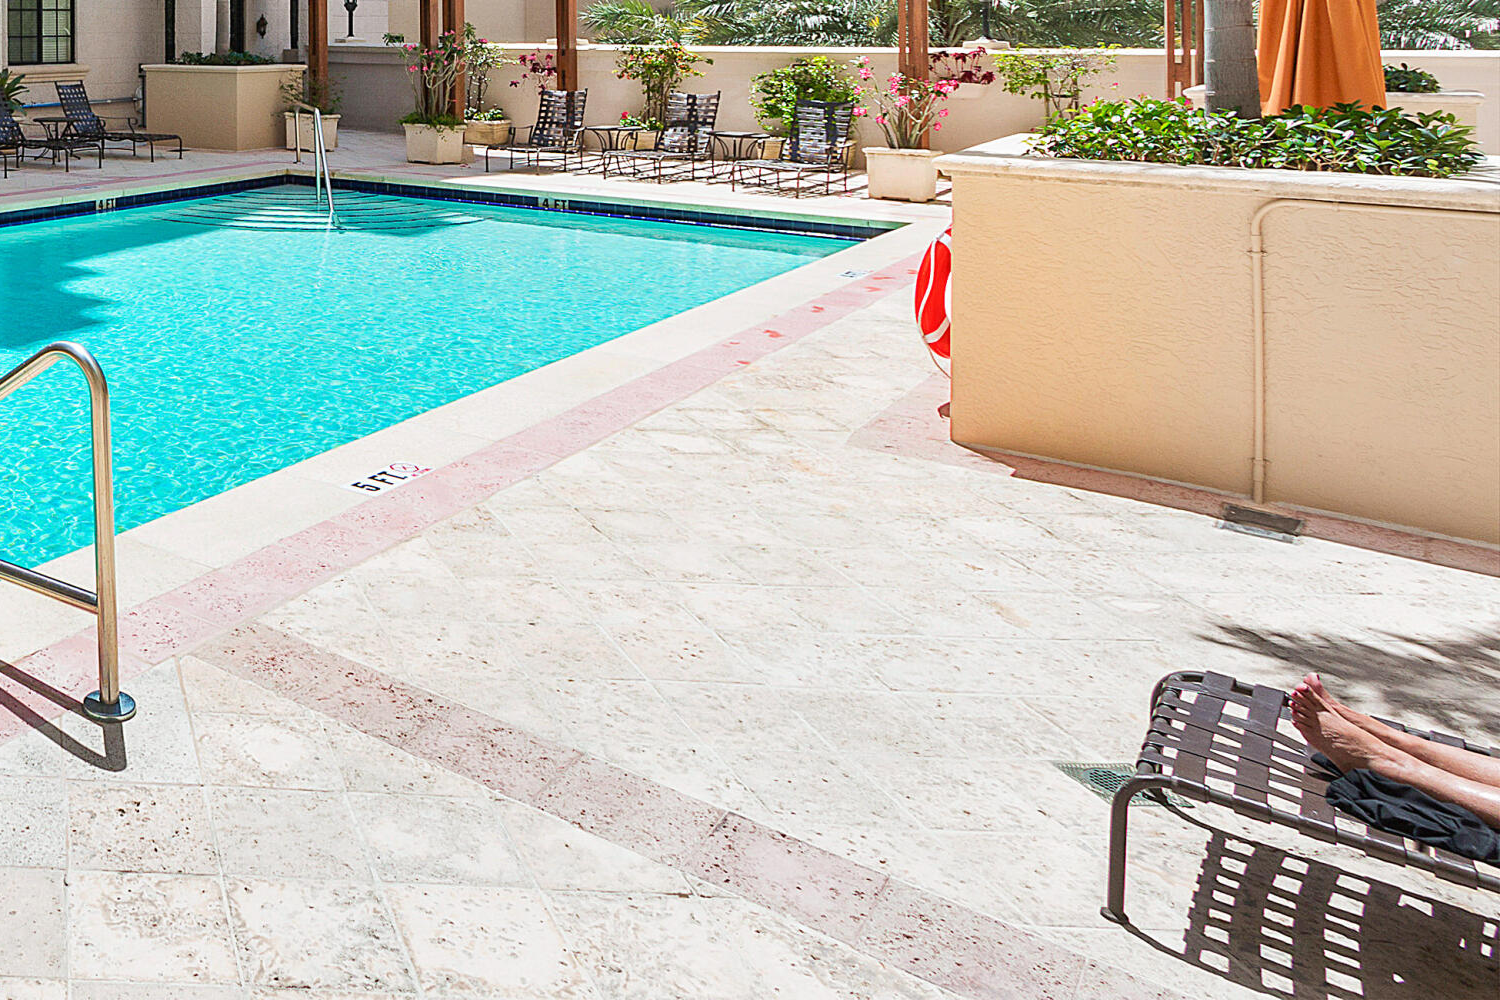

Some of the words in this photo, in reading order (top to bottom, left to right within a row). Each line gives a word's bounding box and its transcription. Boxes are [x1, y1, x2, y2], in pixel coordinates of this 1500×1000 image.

[98, 199, 104, 210] 4
[542, 198, 549, 208] 4
[350, 481, 381, 492] 5
